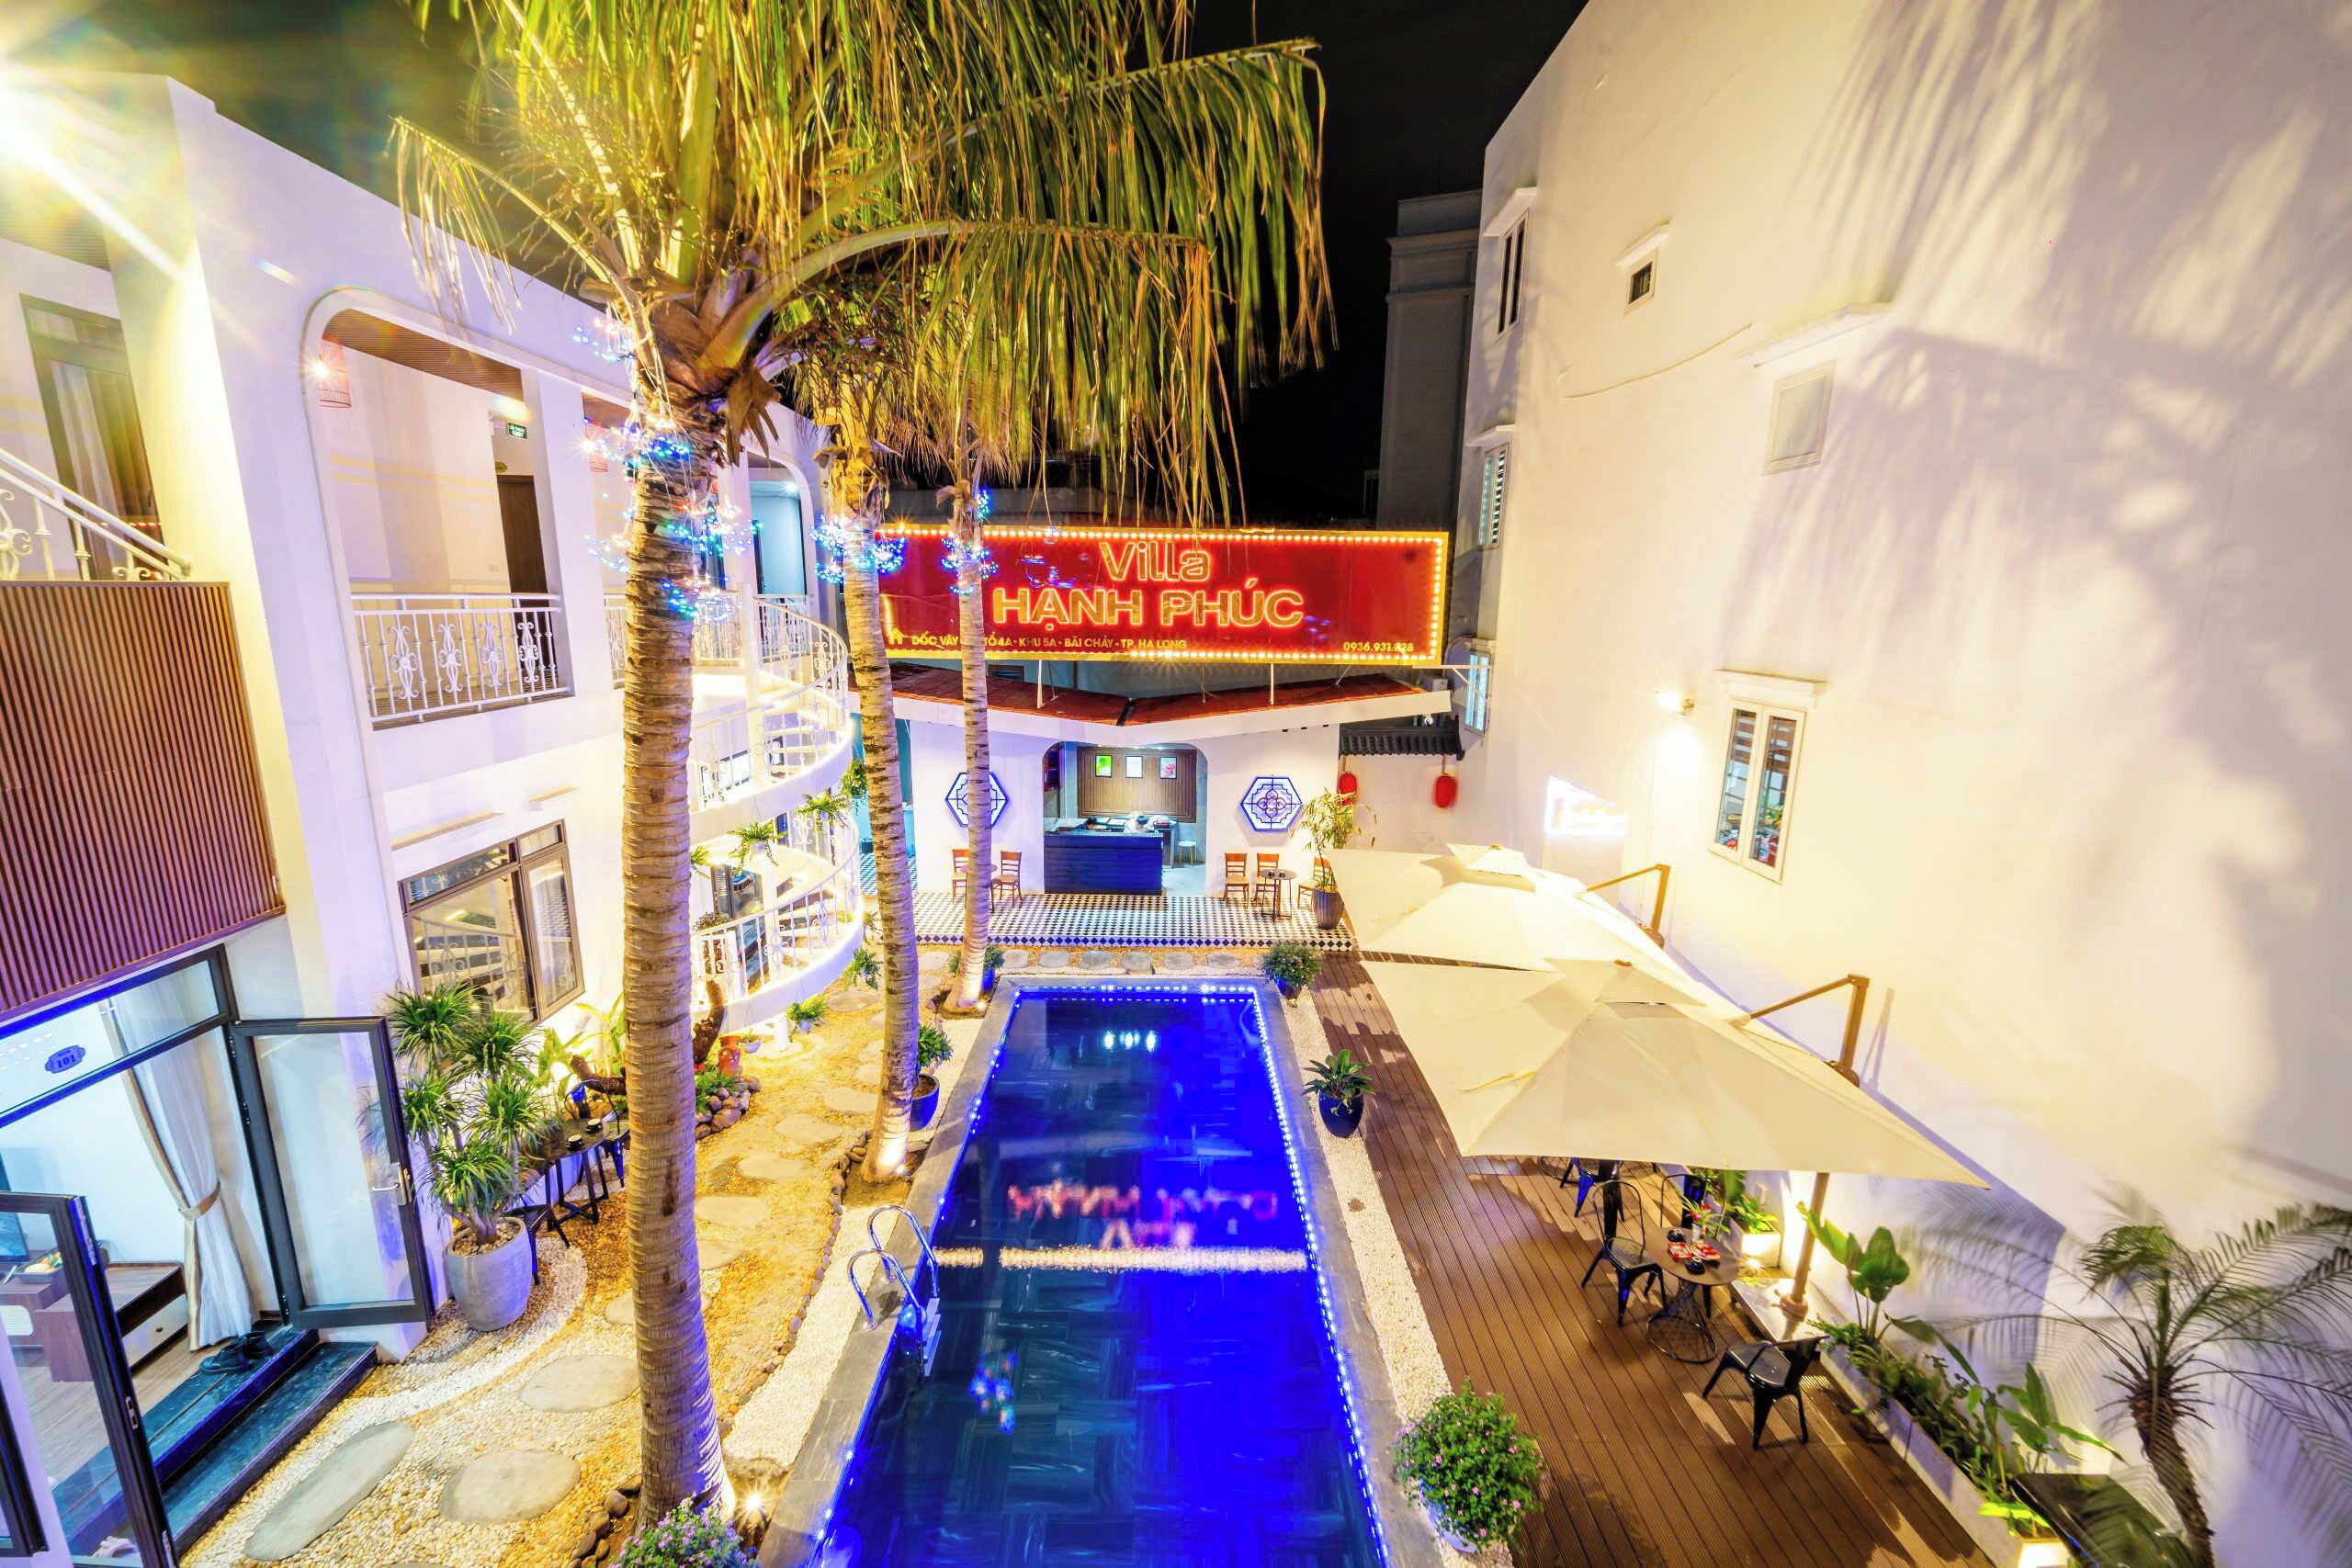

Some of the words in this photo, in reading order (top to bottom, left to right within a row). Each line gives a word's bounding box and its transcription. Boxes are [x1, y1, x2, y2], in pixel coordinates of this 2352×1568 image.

[1100, 540, 1212, 581] Villa
[992, 587, 1142, 631] HẠNH
[1161, 578, 1304, 627] PHÚC
[57, 1055, 76, 1068] 101
